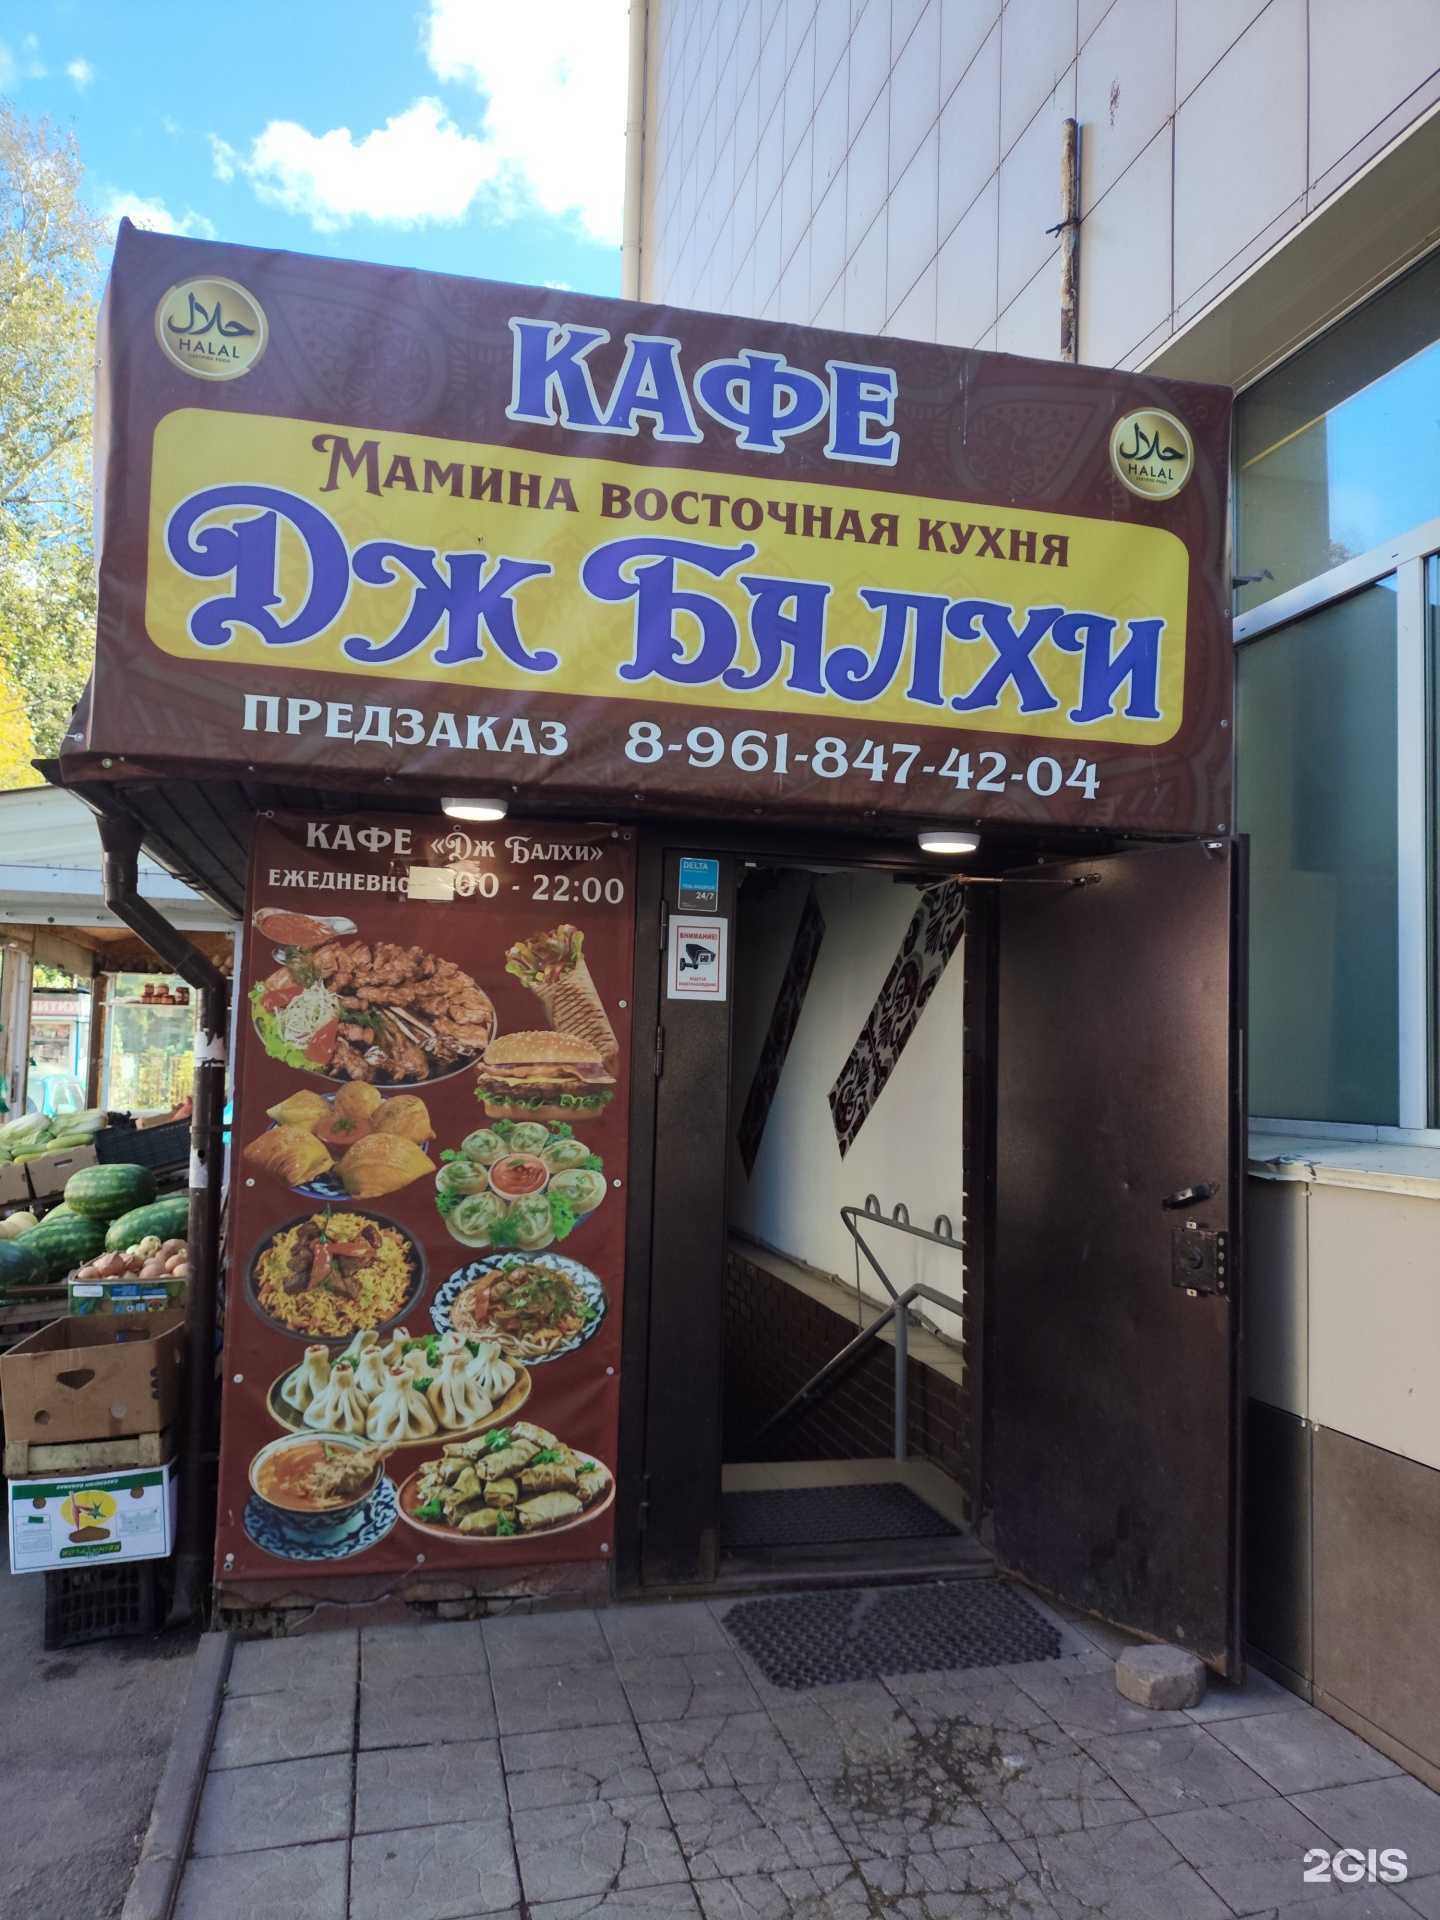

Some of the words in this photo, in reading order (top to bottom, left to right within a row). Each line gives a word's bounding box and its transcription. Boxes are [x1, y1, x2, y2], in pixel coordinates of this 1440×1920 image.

[167, 291, 255, 337] حلال
[178, 338, 241, 359] HALAL
[506, 316, 900, 467] КАФЕ
[1119, 422, 1185, 460] حلال
[1128, 463, 1174, 480] HALAL
[599, 482, 901, 547] ВОСТОЧНАЯ
[918, 517, 1070, 568] КУХНЯ
[242, 694, 569, 756] ПРЕДЗАКАЗ
[623, 720, 1101, 800] 8-961-847-42-04
[306, 822, 413, 855] КАФЕ
[683, 861, 709, 870] DELTA
[531, 874, 625, 904] 22:00
[695, 890, 714, 901] 24/7
